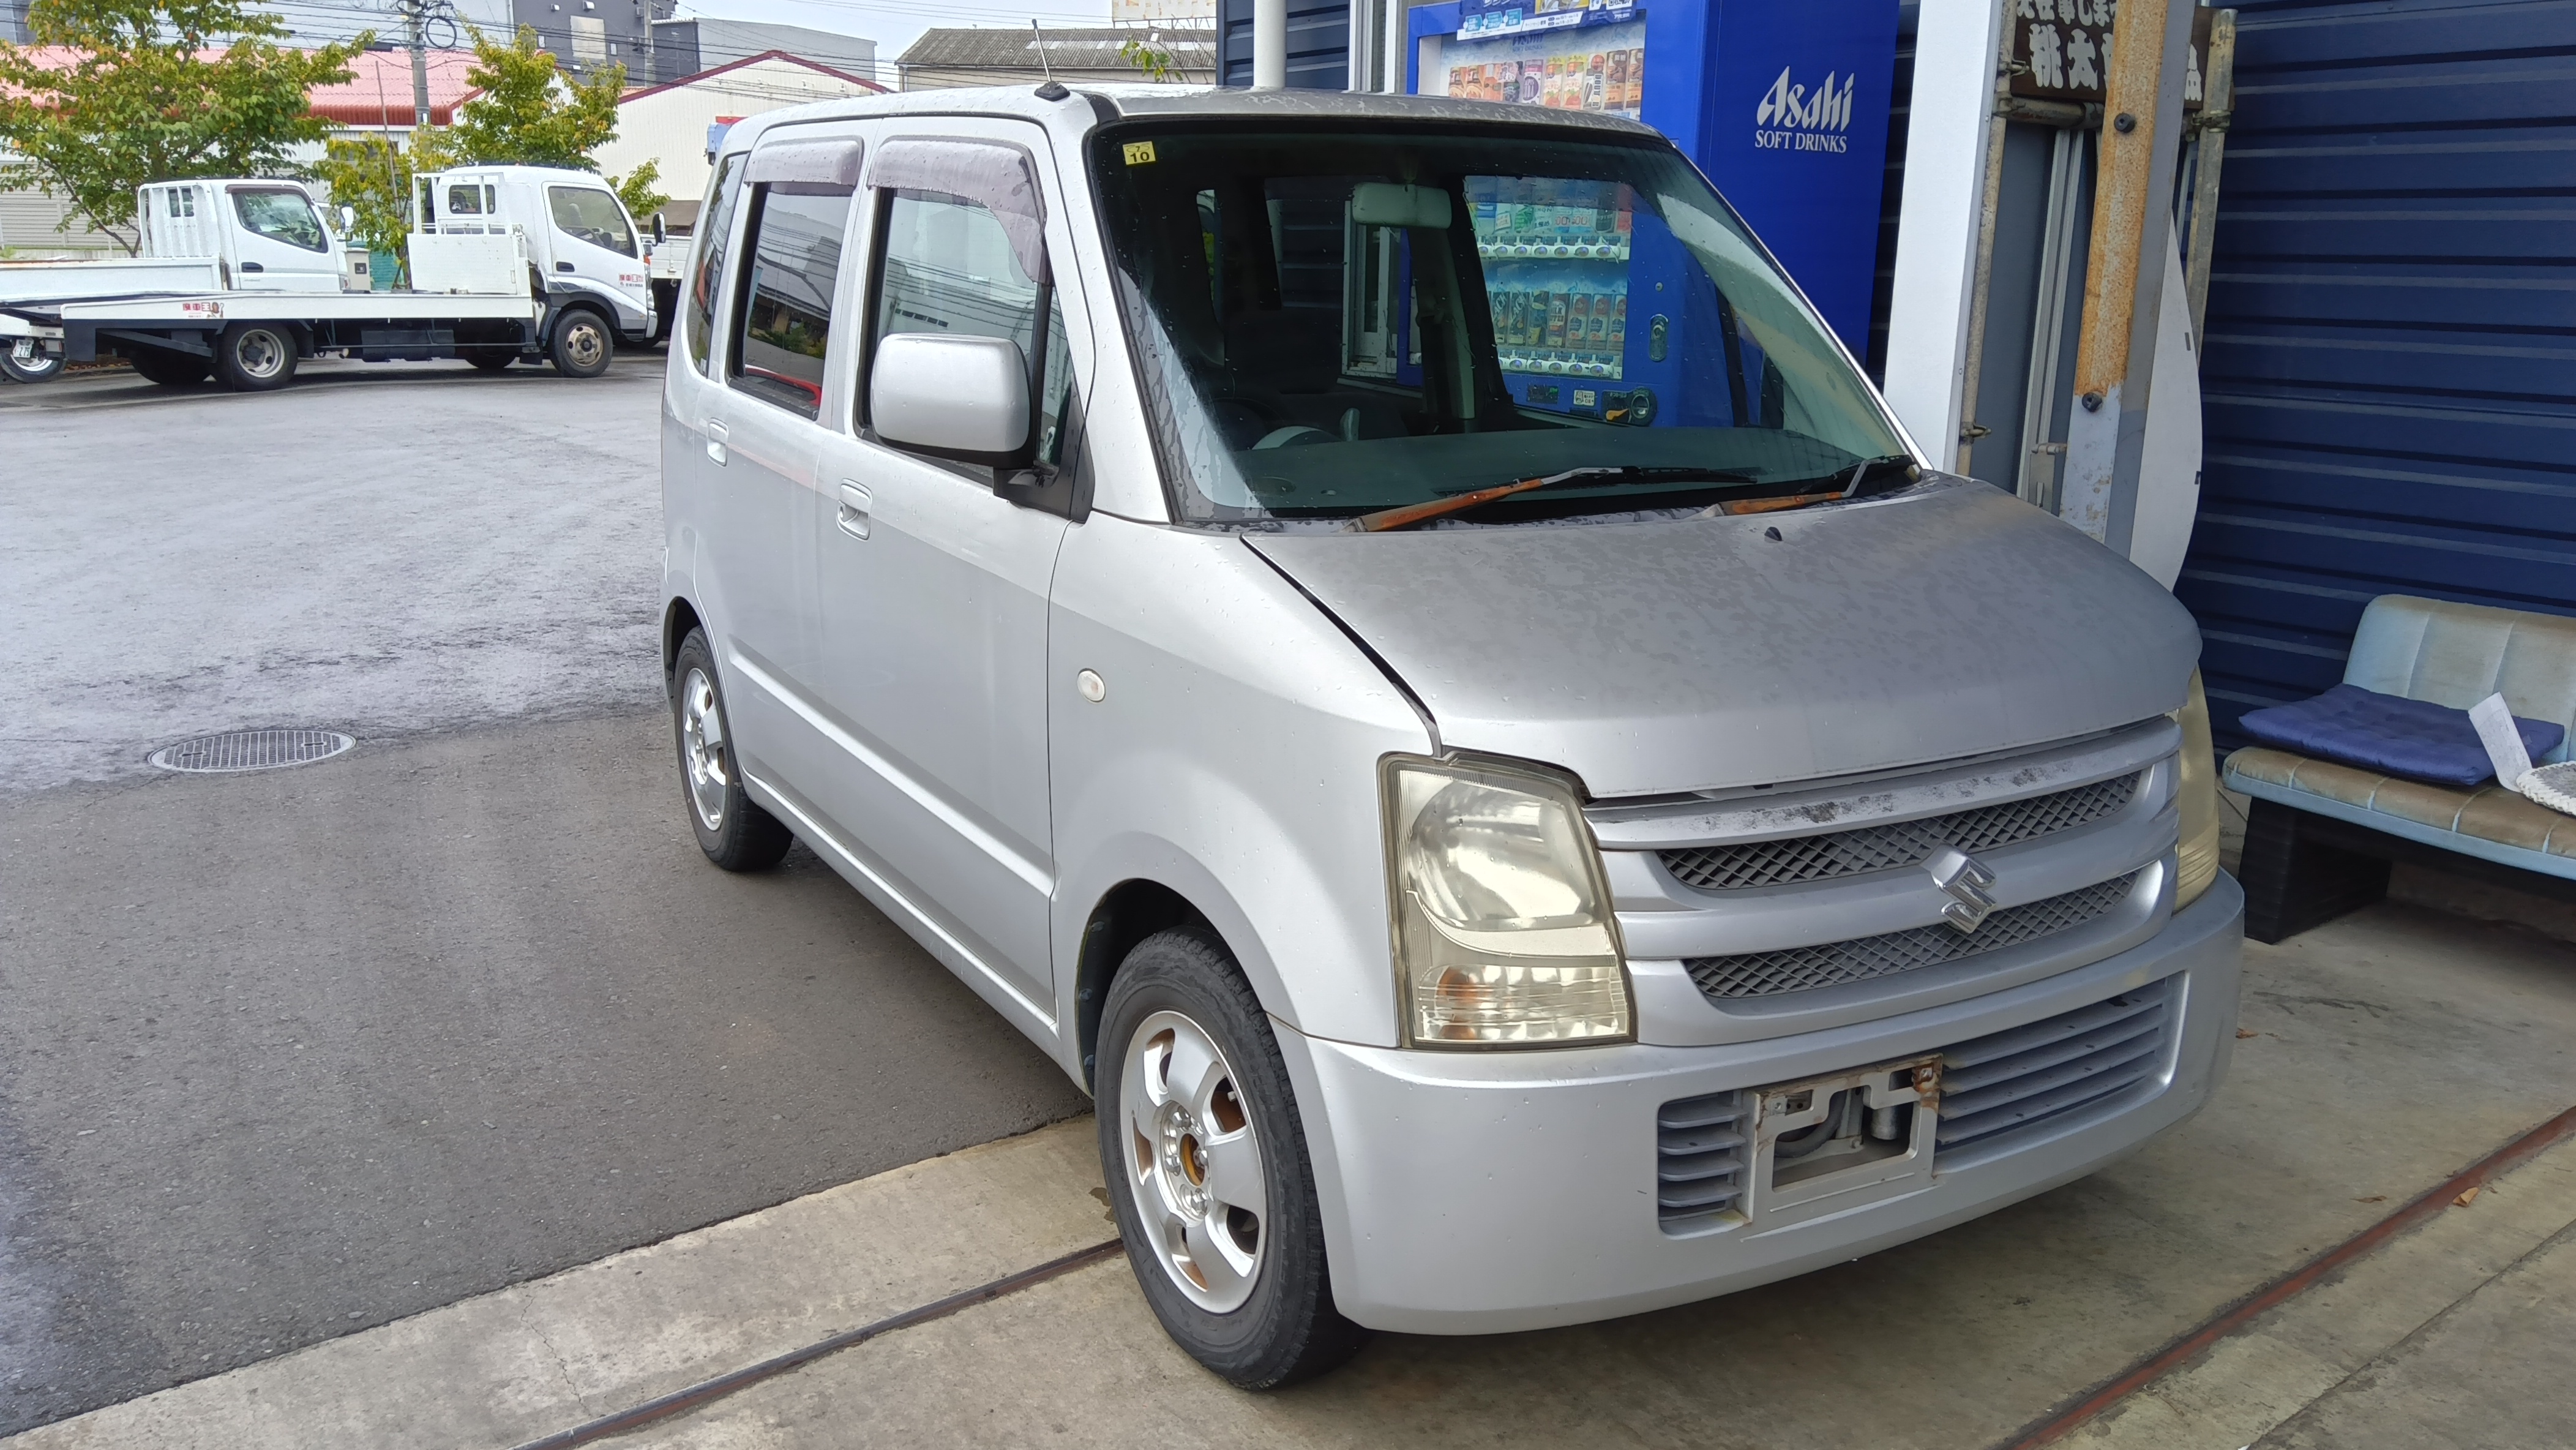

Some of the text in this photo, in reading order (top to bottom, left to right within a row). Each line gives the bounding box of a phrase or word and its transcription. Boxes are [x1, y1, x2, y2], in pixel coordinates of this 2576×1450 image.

[1756, 66, 1854, 132] Asahi
[1754, 129, 1848, 154] SOFT DRINKS
[1130, 151, 1150, 162] 10
